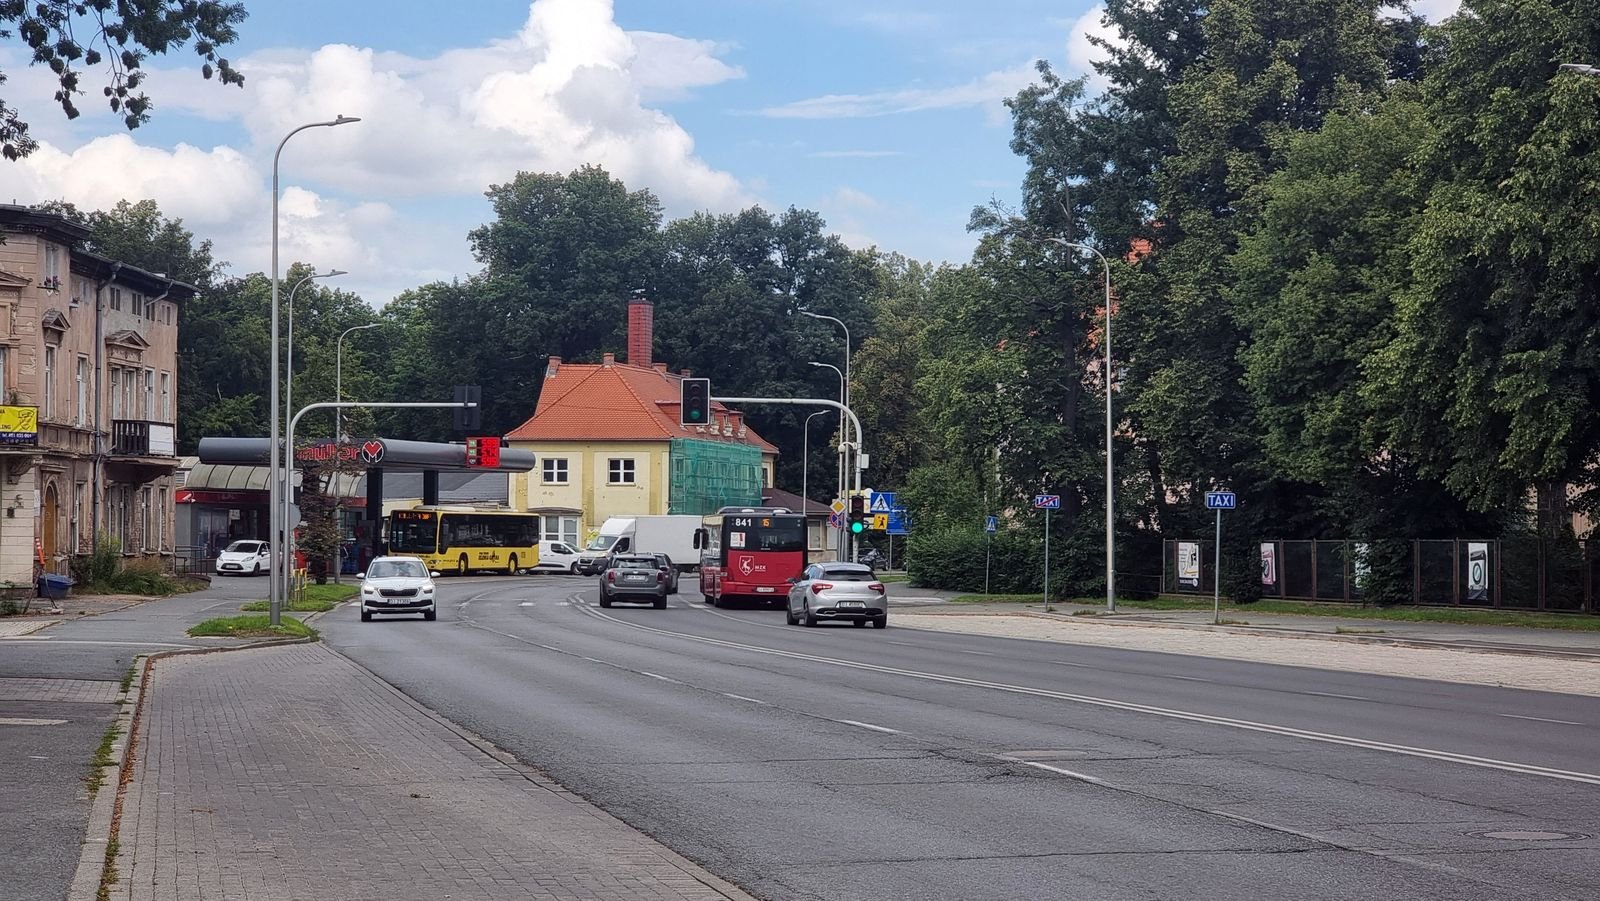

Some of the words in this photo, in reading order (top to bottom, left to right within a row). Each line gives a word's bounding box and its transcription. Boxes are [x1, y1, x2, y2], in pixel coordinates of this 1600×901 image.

[1036, 497, 1058, 506] TAXI
[1208, 495, 1234, 506] TAXI
[735, 518, 752, 527] 841
